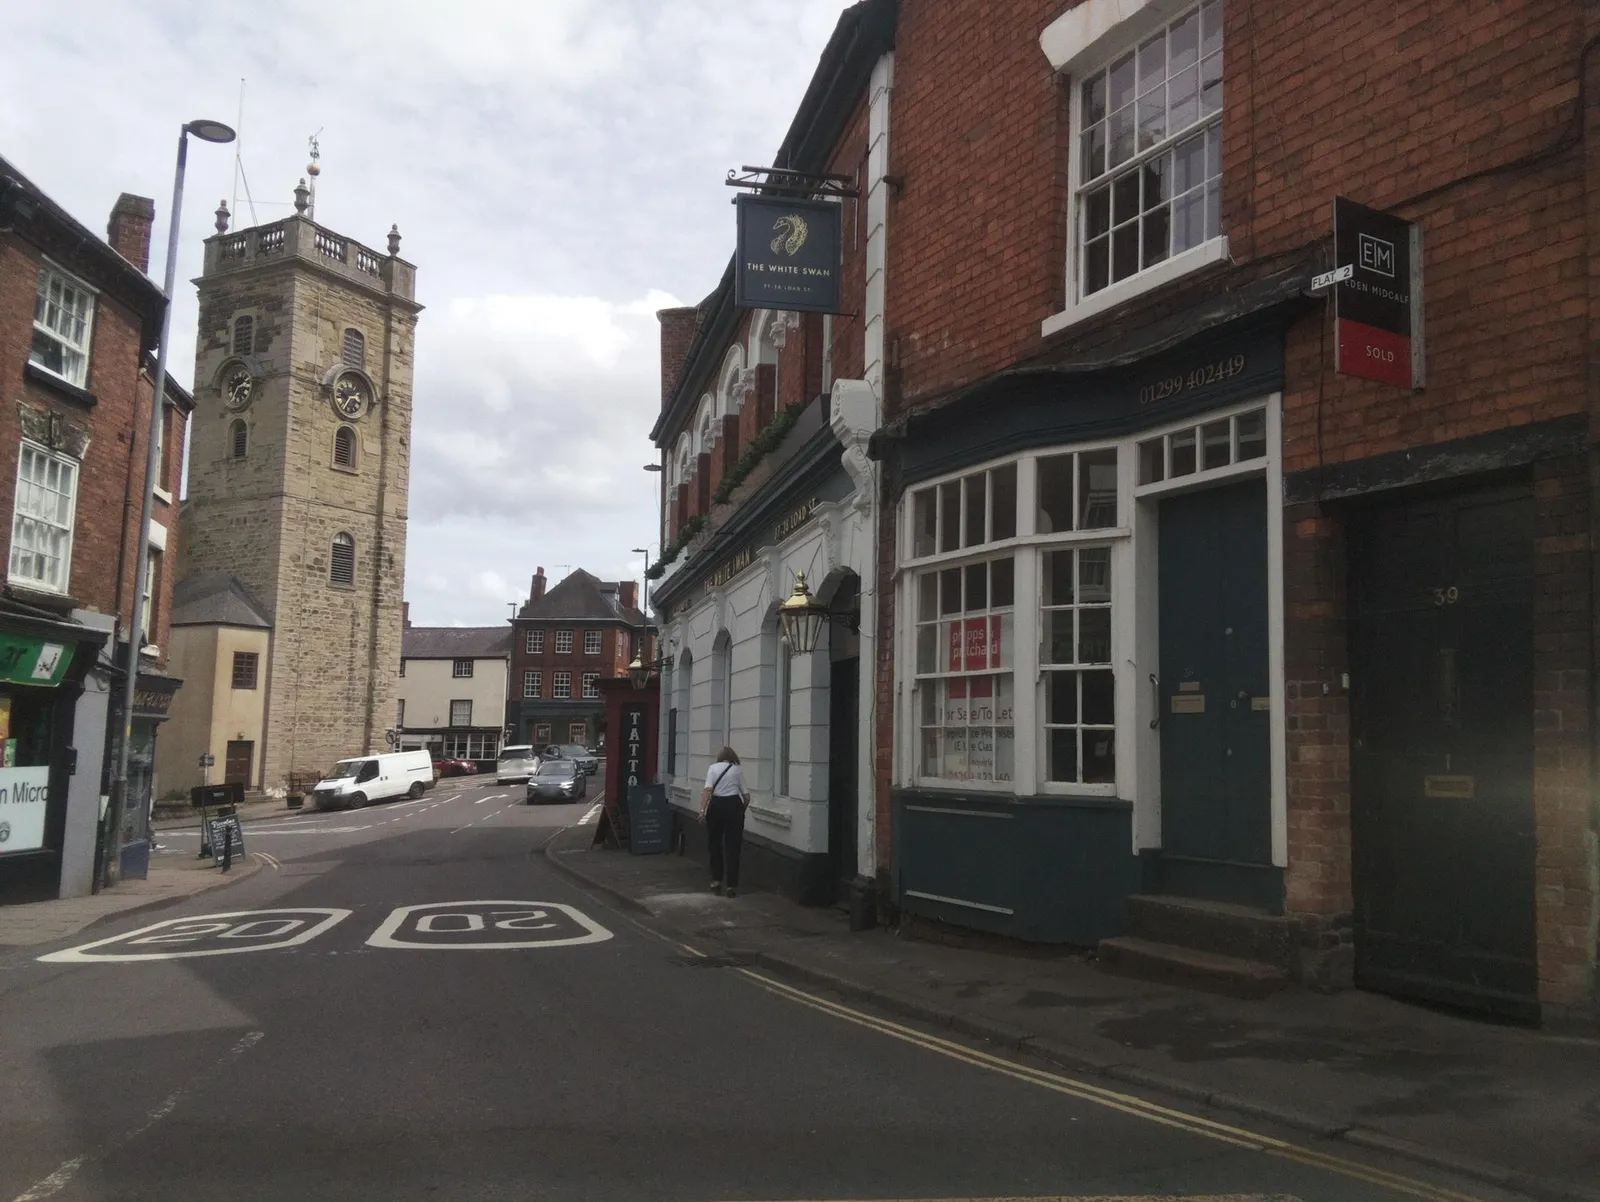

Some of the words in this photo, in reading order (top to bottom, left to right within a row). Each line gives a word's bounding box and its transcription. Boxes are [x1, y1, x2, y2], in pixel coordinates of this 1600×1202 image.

[746, 262, 765, 272] THE
[768, 264, 799, 274] WHITE
[802, 267, 831, 277] SWAN
[1312, 270, 1336, 288] FLAT
[1343, 267, 1351, 278] 2
[1344, 279, 1369, 293] EDEN
[1366, 345, 1394, 362] SOLD
[1140, 375, 1183, 404] 01299
[1186, 354, 1245, 390] 402449
[1433, 586, 1459, 606] 39
[415, 910, 557, 932] 20
[125, 919, 305, 944] 20
